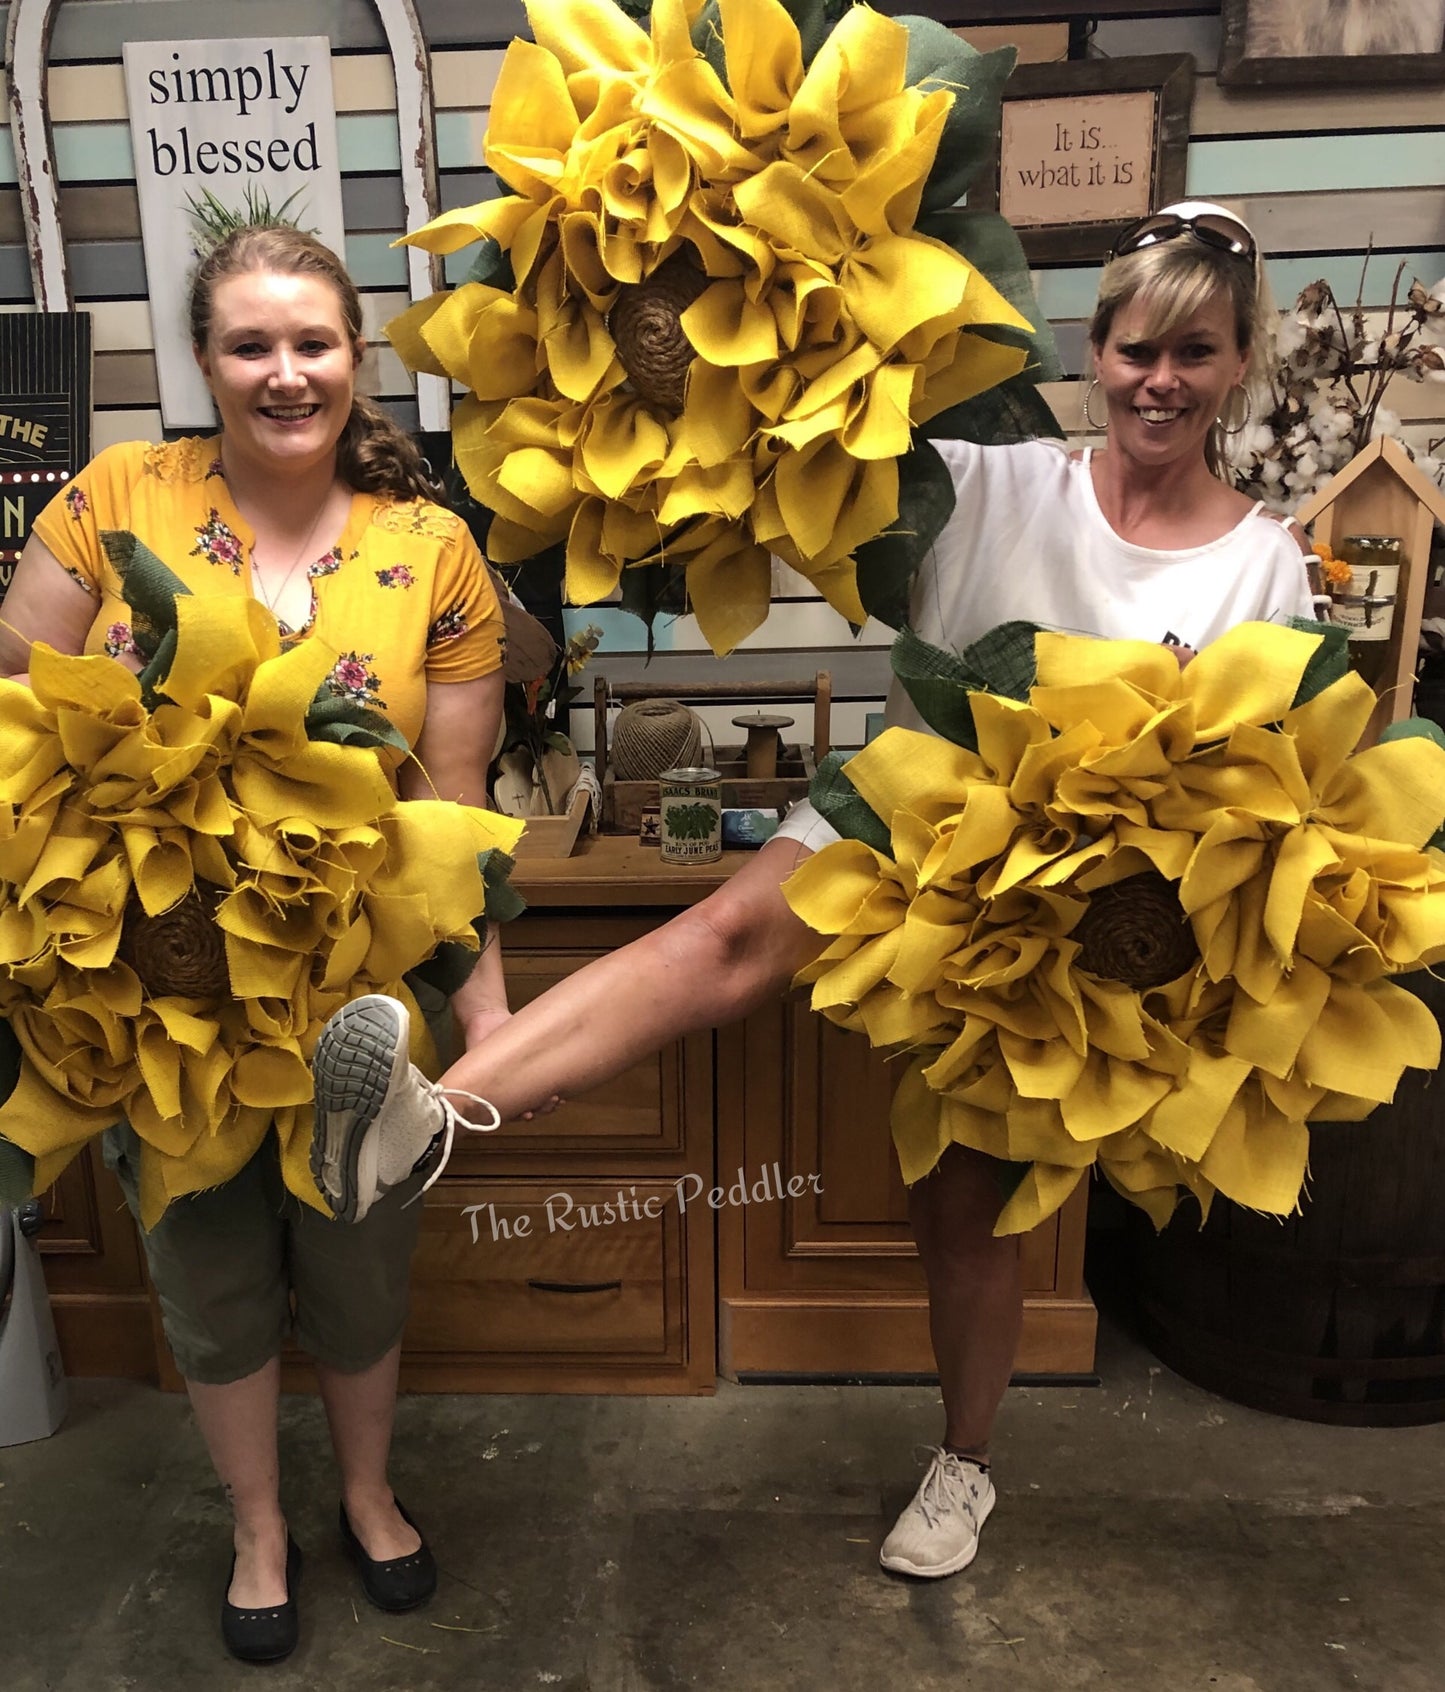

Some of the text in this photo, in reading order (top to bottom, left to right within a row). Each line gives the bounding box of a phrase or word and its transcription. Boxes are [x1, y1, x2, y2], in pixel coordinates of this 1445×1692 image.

[148, 49, 310, 116] simply
[146, 122, 322, 176] blessed
[1054, 123, 1073, 151] It
[1018, 155, 1133, 189] what it is
[0, 414, 49, 449] THE
[665, 845, 682, 855] EARLY
[683, 846, 703, 855] JUNE
